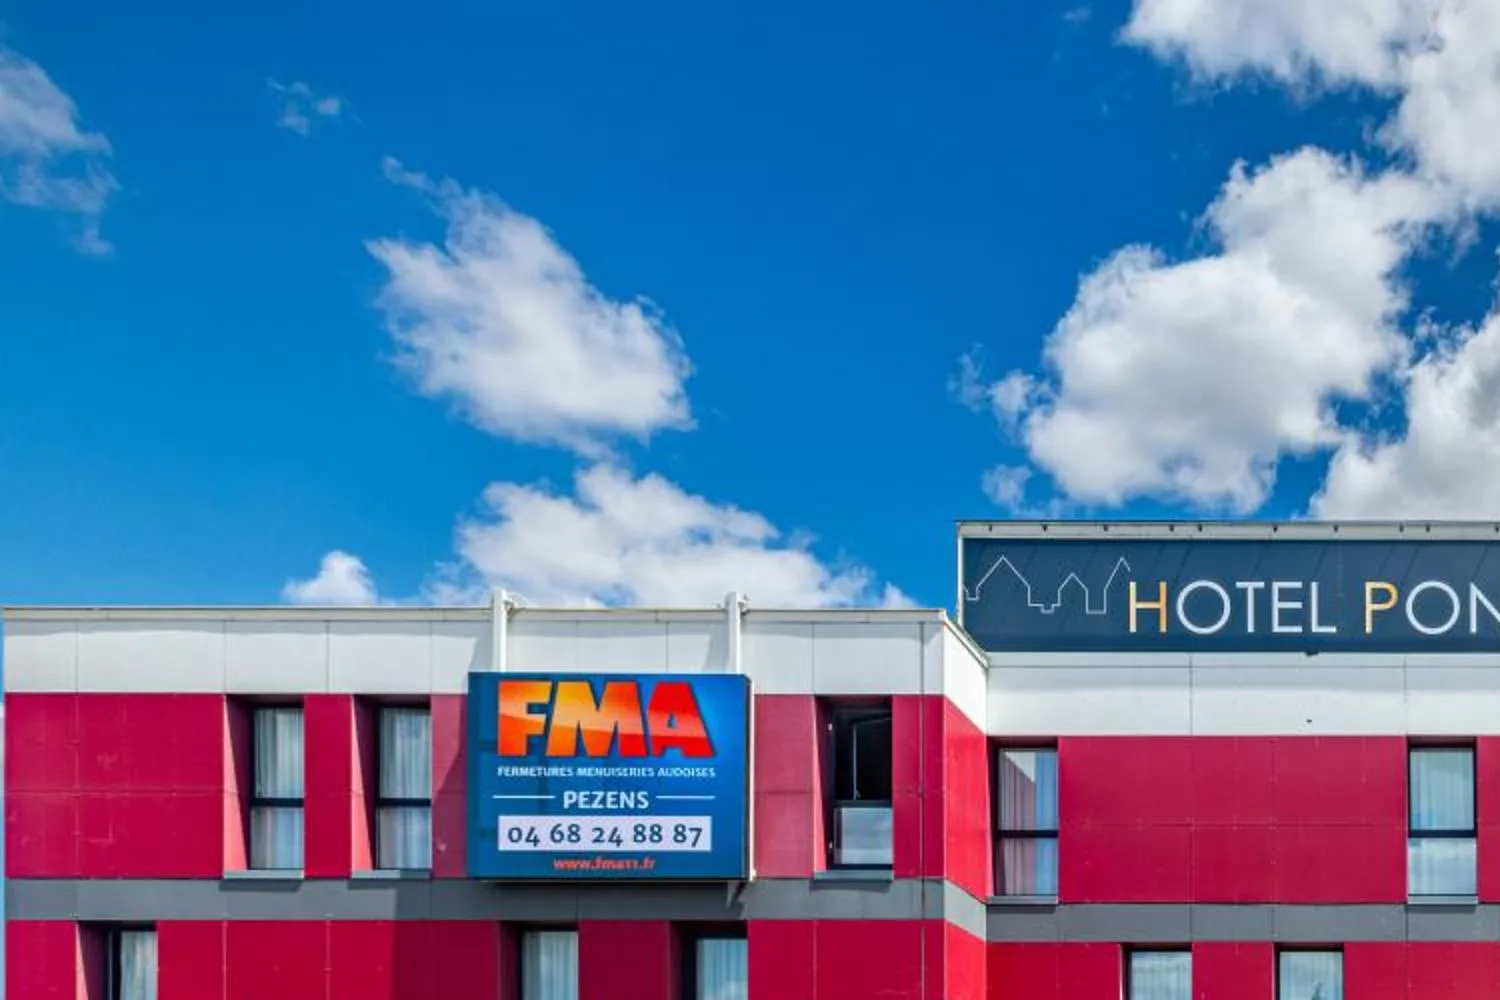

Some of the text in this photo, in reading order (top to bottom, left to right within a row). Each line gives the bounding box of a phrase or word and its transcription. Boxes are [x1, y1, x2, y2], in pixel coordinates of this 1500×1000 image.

[1129, 580, 1337, 634] HOTEL
[497, 680, 716, 757] FMA
[497, 766, 716, 777] FERMETURES MENUISERIES AUDOISES
[563, 790, 649, 809] PEZENS
[507, 823, 703, 848] 04 68 24 88 87
